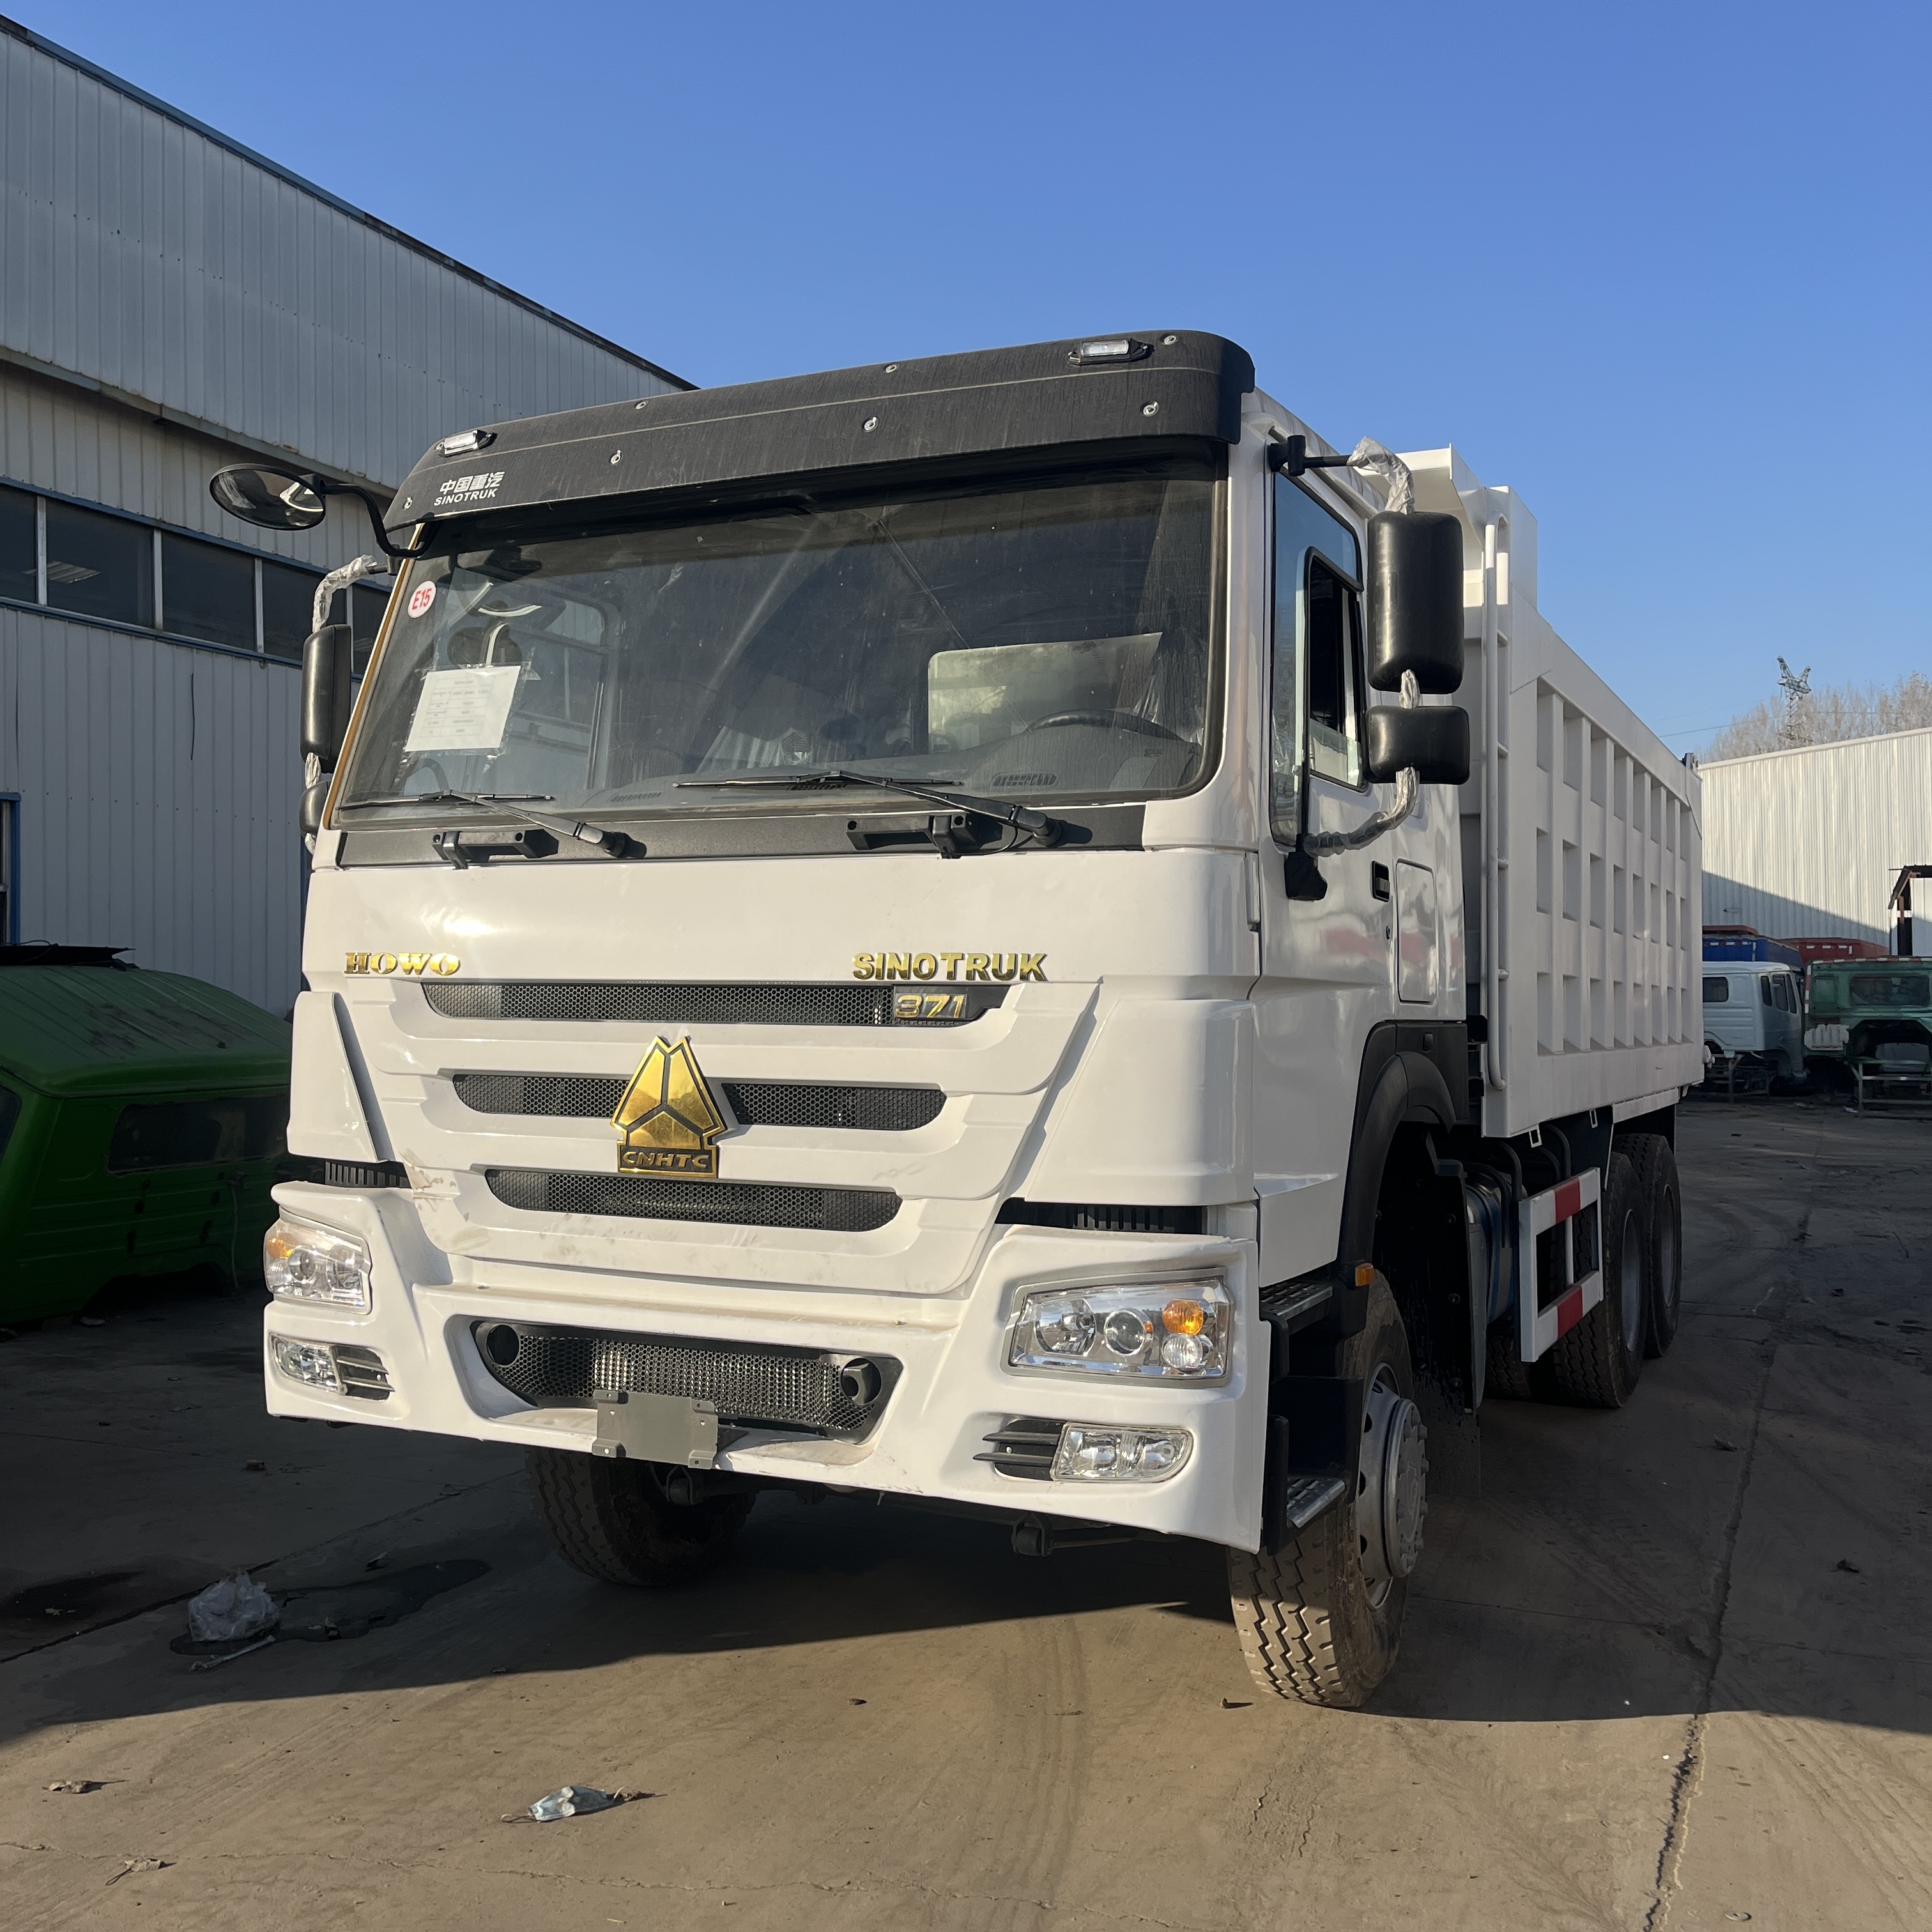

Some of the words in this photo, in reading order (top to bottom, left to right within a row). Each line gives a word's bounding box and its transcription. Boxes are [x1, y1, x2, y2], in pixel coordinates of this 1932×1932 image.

[440, 471, 505, 494] 中国重汽
[434, 489, 496, 506] SINOTRUK
[412, 588, 432, 610] E15
[344, 953, 461, 975] HOWO
[852, 953, 1048, 981] SINOTRUK
[896, 995, 965, 1018] 371
[623, 1151, 709, 1168] CNHTC
